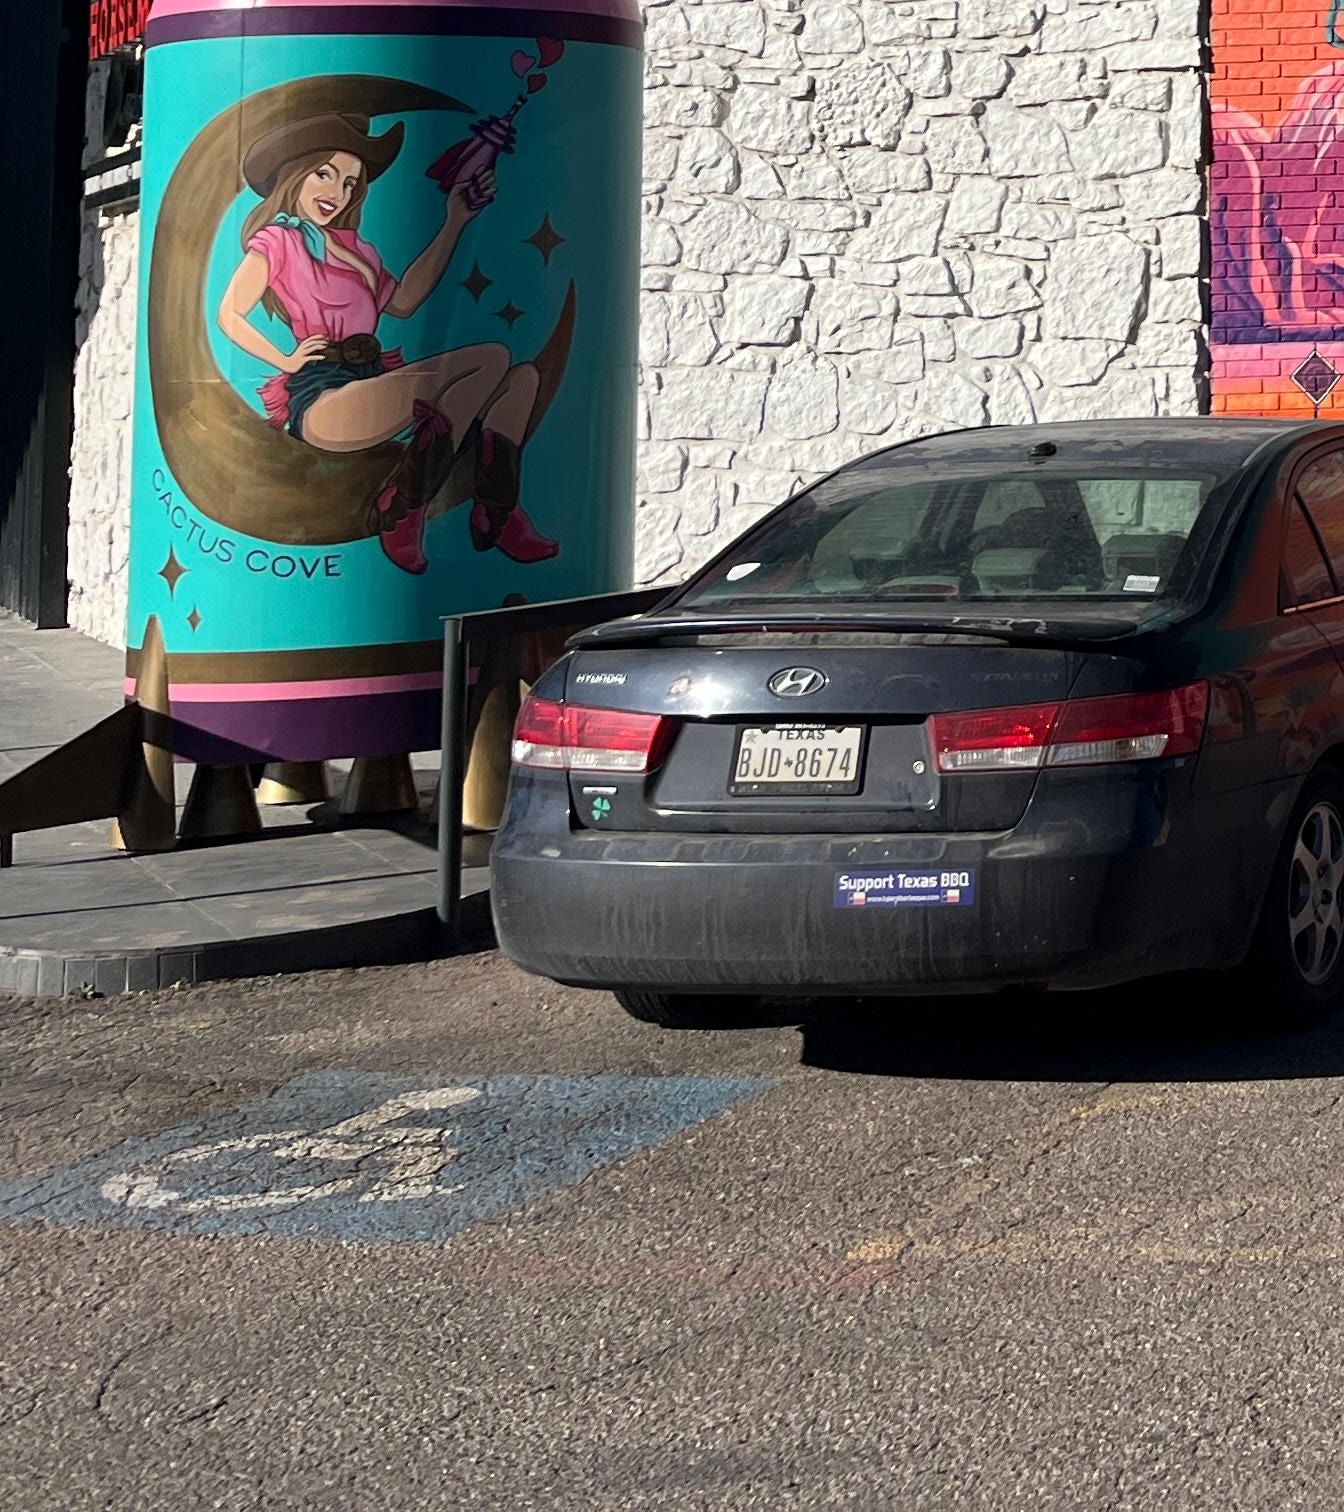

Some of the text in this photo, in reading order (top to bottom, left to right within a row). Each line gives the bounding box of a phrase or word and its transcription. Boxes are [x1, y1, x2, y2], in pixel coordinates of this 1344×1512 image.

[151, 468, 343, 579] CACTUS COVE
[576, 673, 626, 685] HYUNDAI
[778, 729, 825, 740] TEXAS
[738, 748, 852, 778] BJD 8674
[839, 871, 970, 892] Support Texas BBQ
